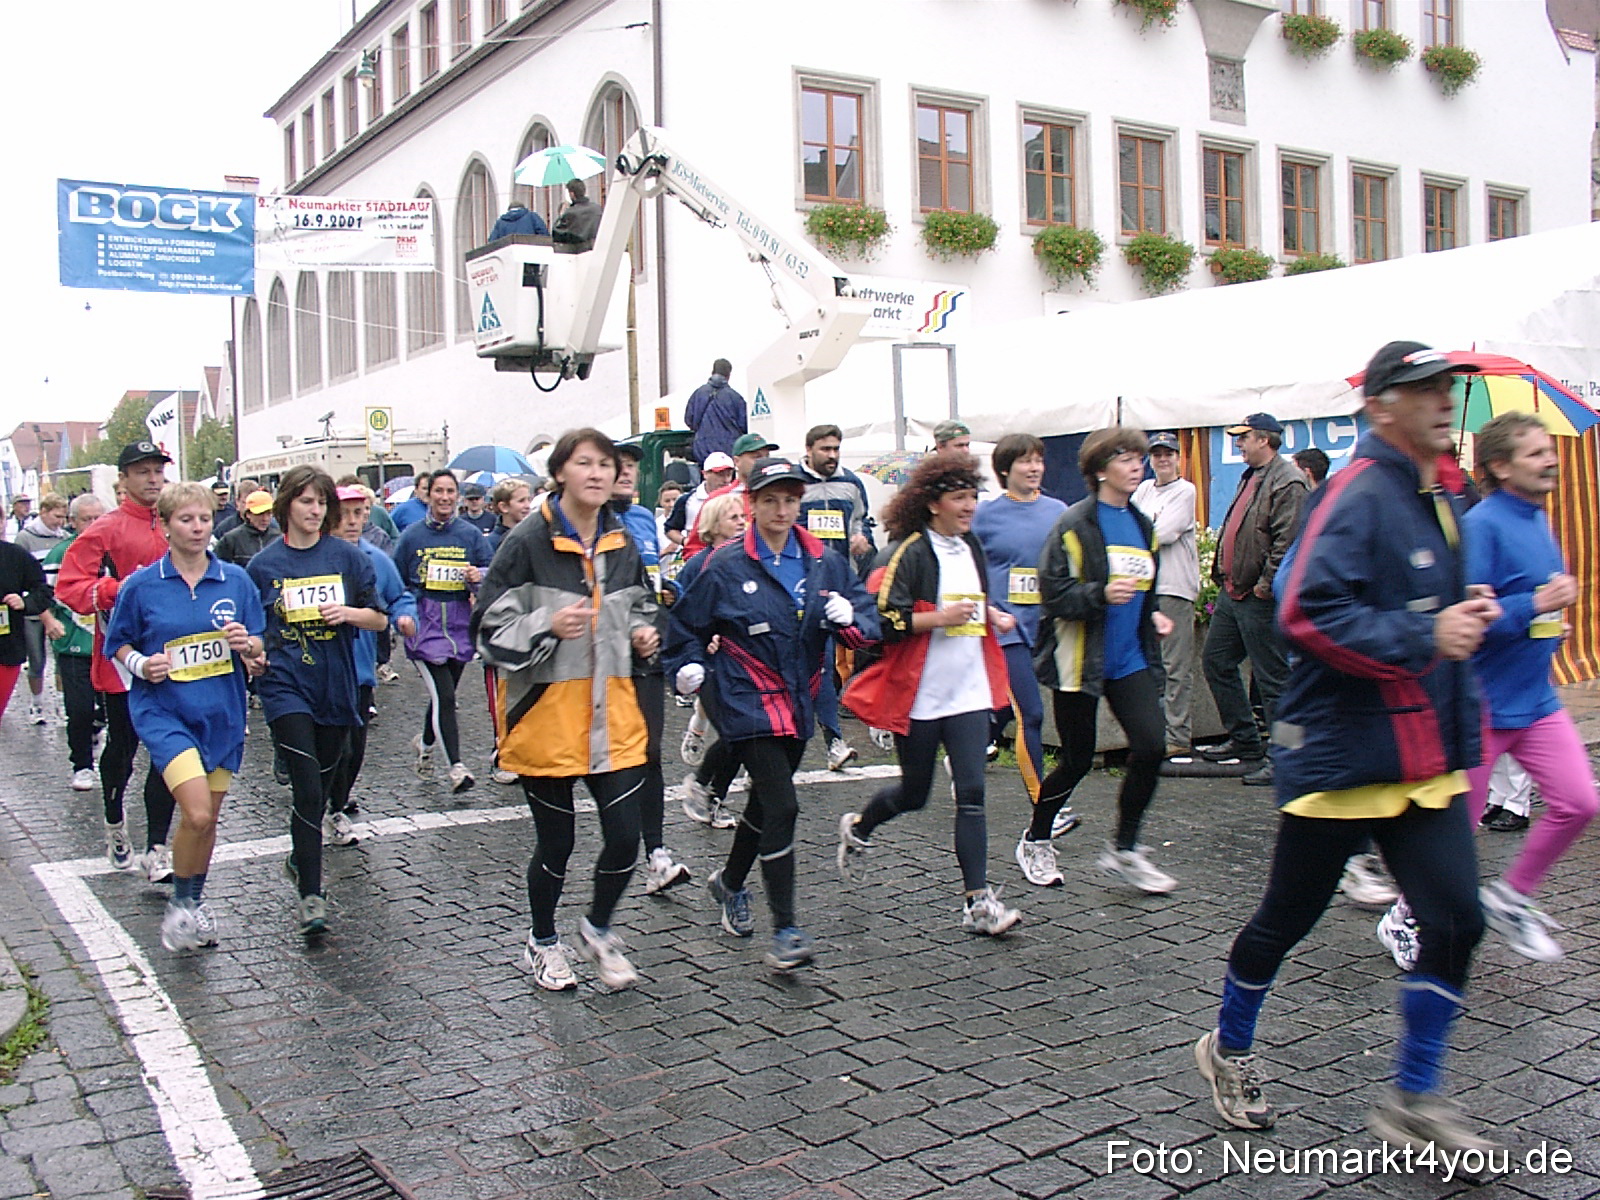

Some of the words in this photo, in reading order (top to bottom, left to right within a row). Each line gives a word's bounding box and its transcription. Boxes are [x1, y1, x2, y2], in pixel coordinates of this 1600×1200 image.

[69, 187, 243, 233] BOCK
[258, 198, 270, 208] 2.
[288, 198, 362, 212] Neumarkter
[293, 213, 363, 229] 16.9.2001
[672, 161, 730, 215] JGS-Mietservice
[760, 230, 769, 247] 91
[795, 261, 809, 279] 52
[817, 516, 840, 528] 1756
[297, 584, 337, 605] 1751
[179, 640, 223, 664] 1750
